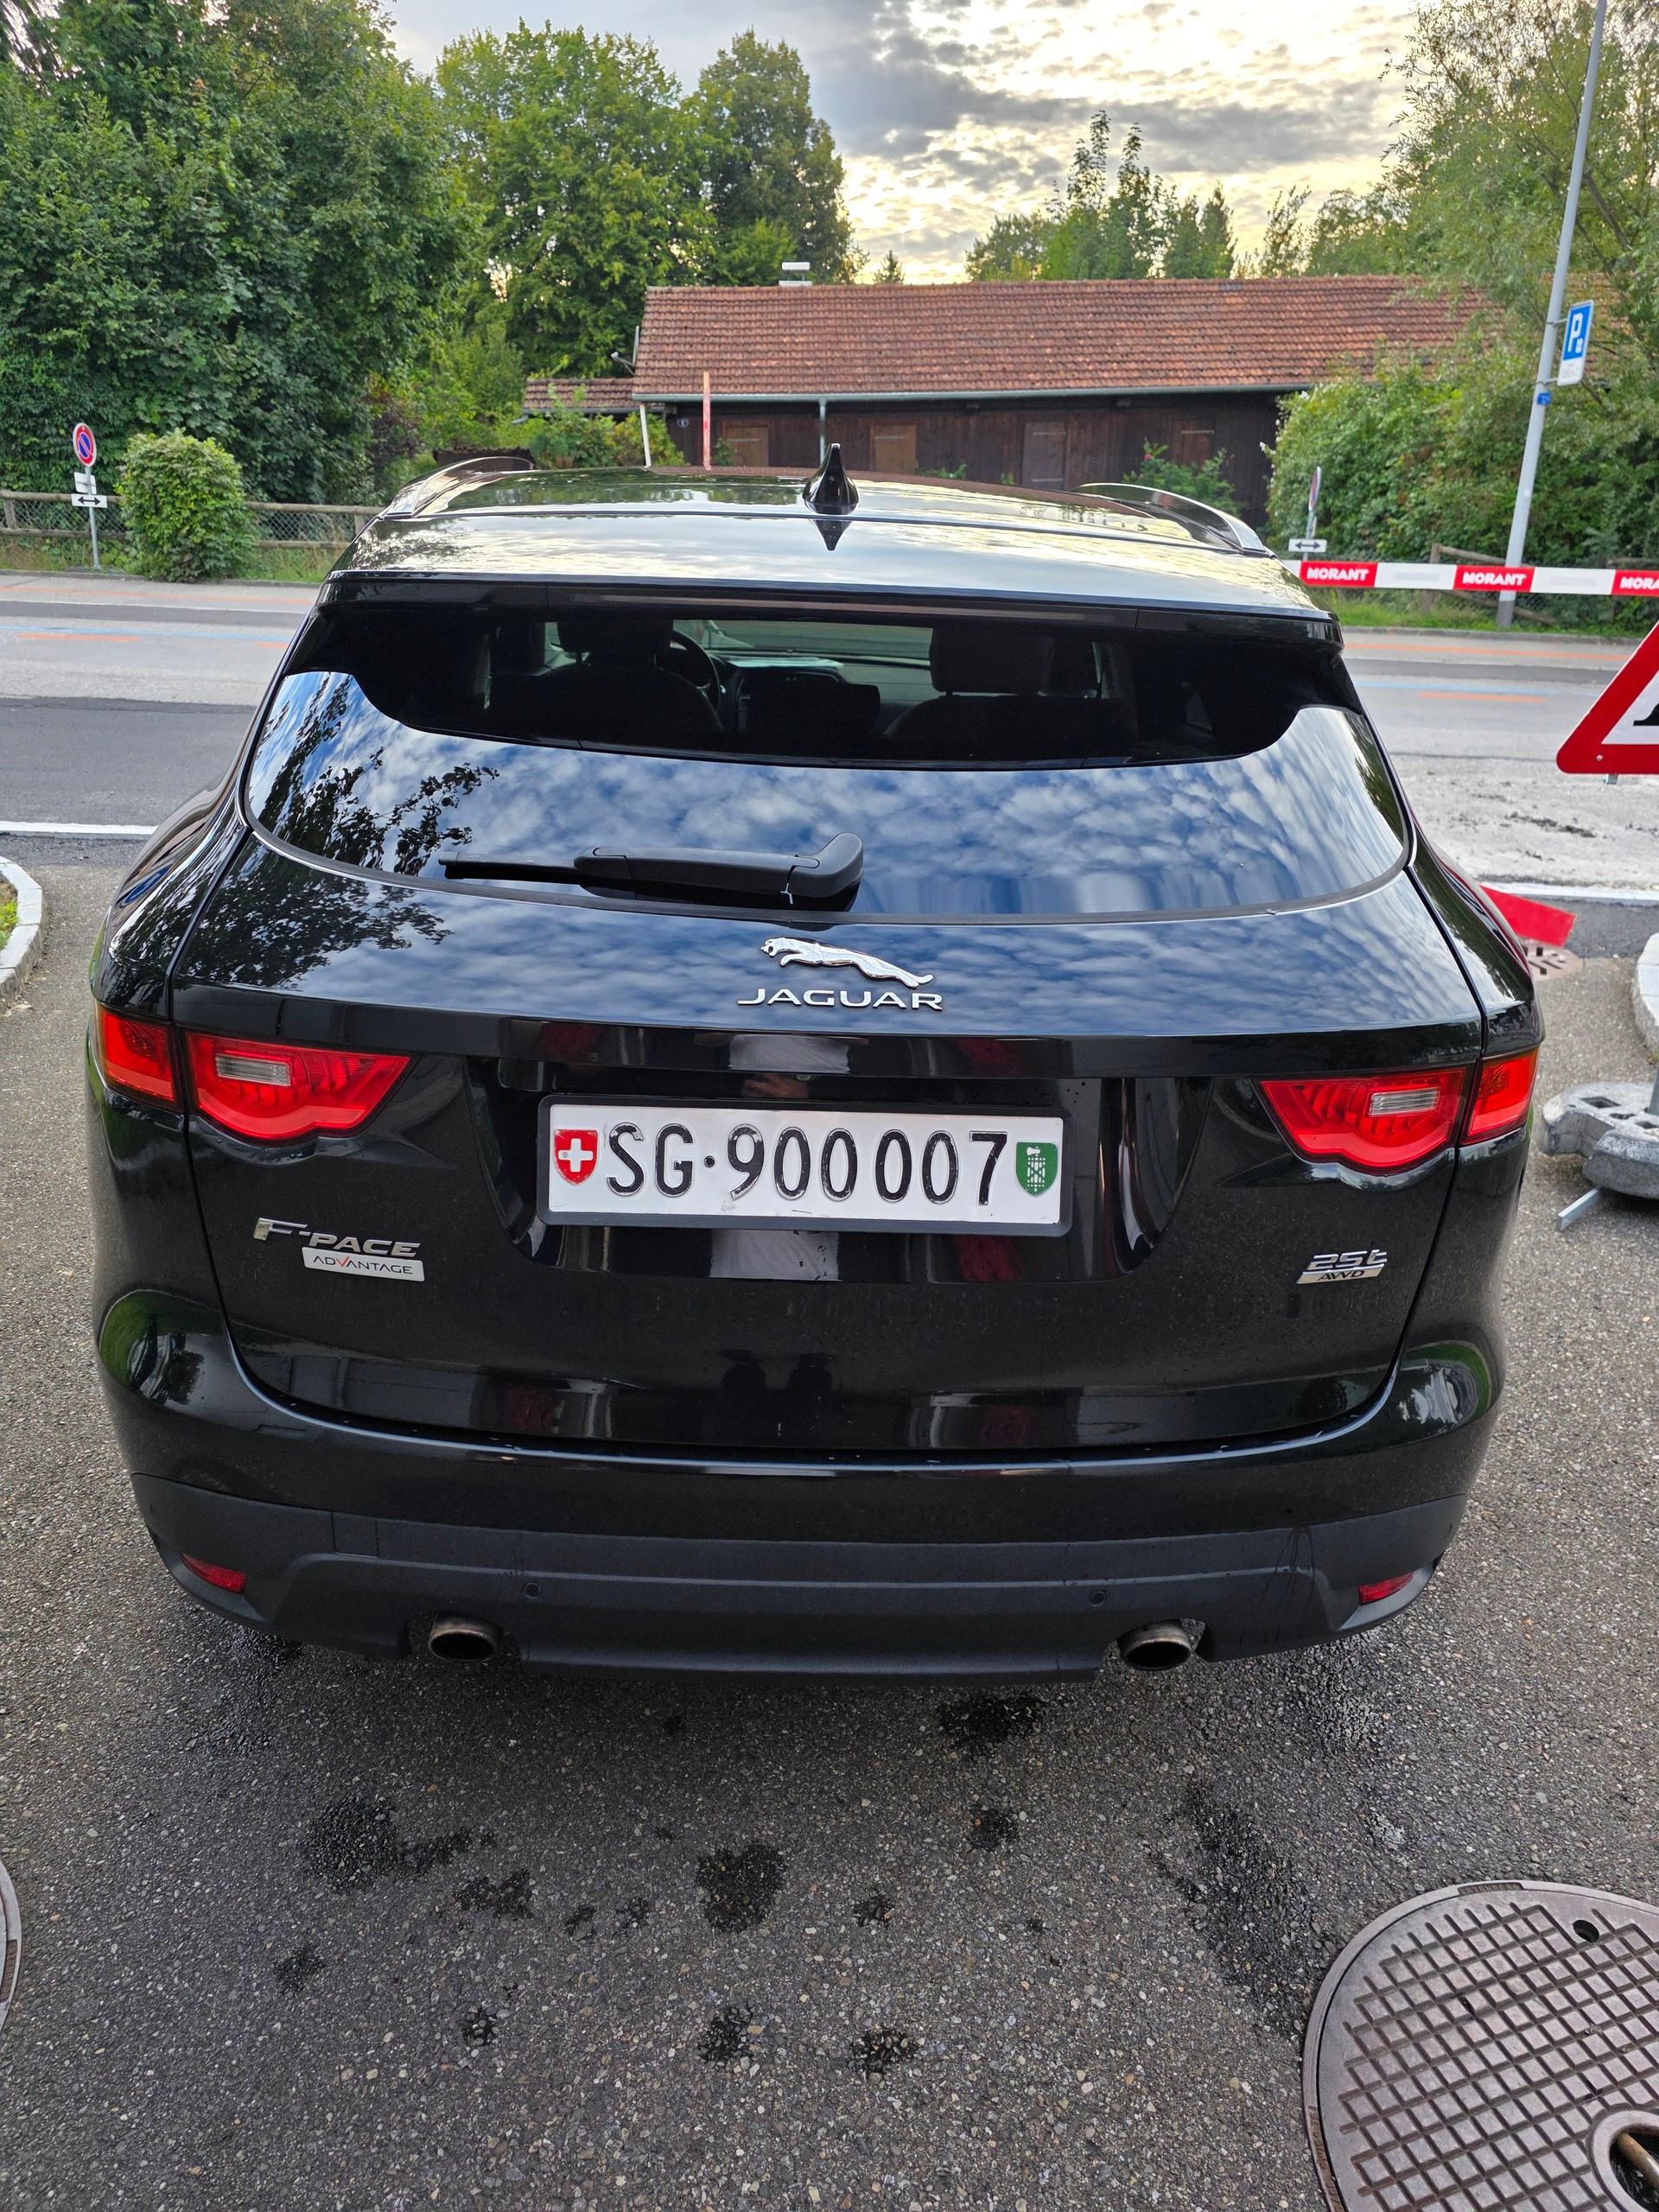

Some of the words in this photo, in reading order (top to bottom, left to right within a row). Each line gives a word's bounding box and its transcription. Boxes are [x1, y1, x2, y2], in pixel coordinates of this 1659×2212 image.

[1567, 312, 1584, 353] P
[1306, 567, 1370, 582] MORANT
[1462, 572, 1527, 586] MORANT
[737, 988, 943, 1011] JAGUAR
[252, 1217, 422, 1258] F-PACE
[313, 1255, 414, 1275] ADVANTAGE
[1317, 1270, 1365, 1281] AWD
